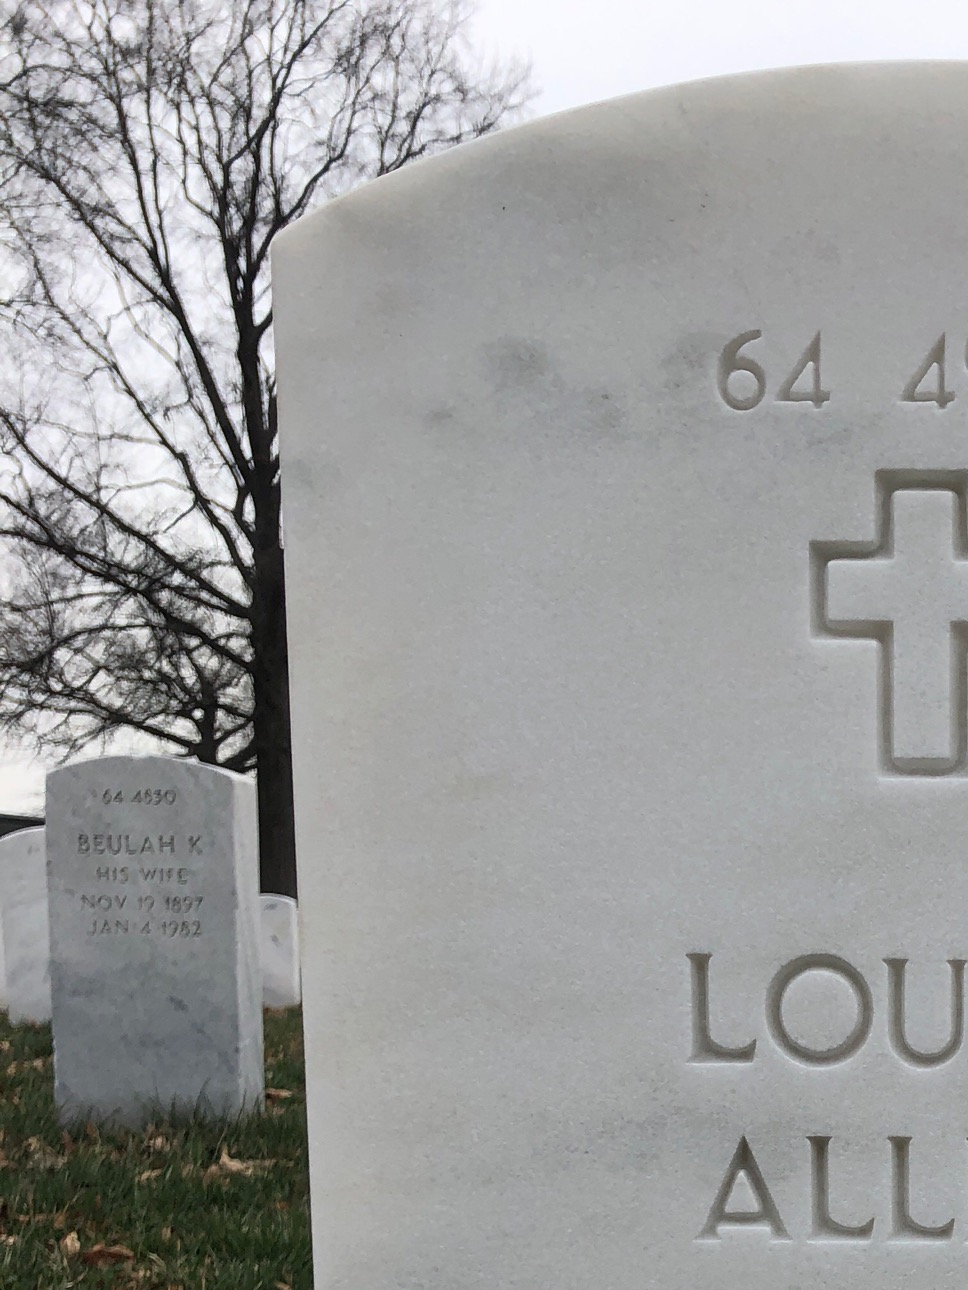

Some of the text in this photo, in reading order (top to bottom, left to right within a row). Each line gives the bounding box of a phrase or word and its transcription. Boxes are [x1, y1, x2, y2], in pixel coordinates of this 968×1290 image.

[716, 328, 831, 412] 64
[102, 788, 124, 805] 64
[77, 833, 203, 855] BEULAH K
[95, 866, 188, 885] HIS WIFE
[81, 894, 127, 912] NOV
[164, 895, 204, 913] 1897
[86, 919, 129, 936] JAN
[140, 920, 152, 935] 4
